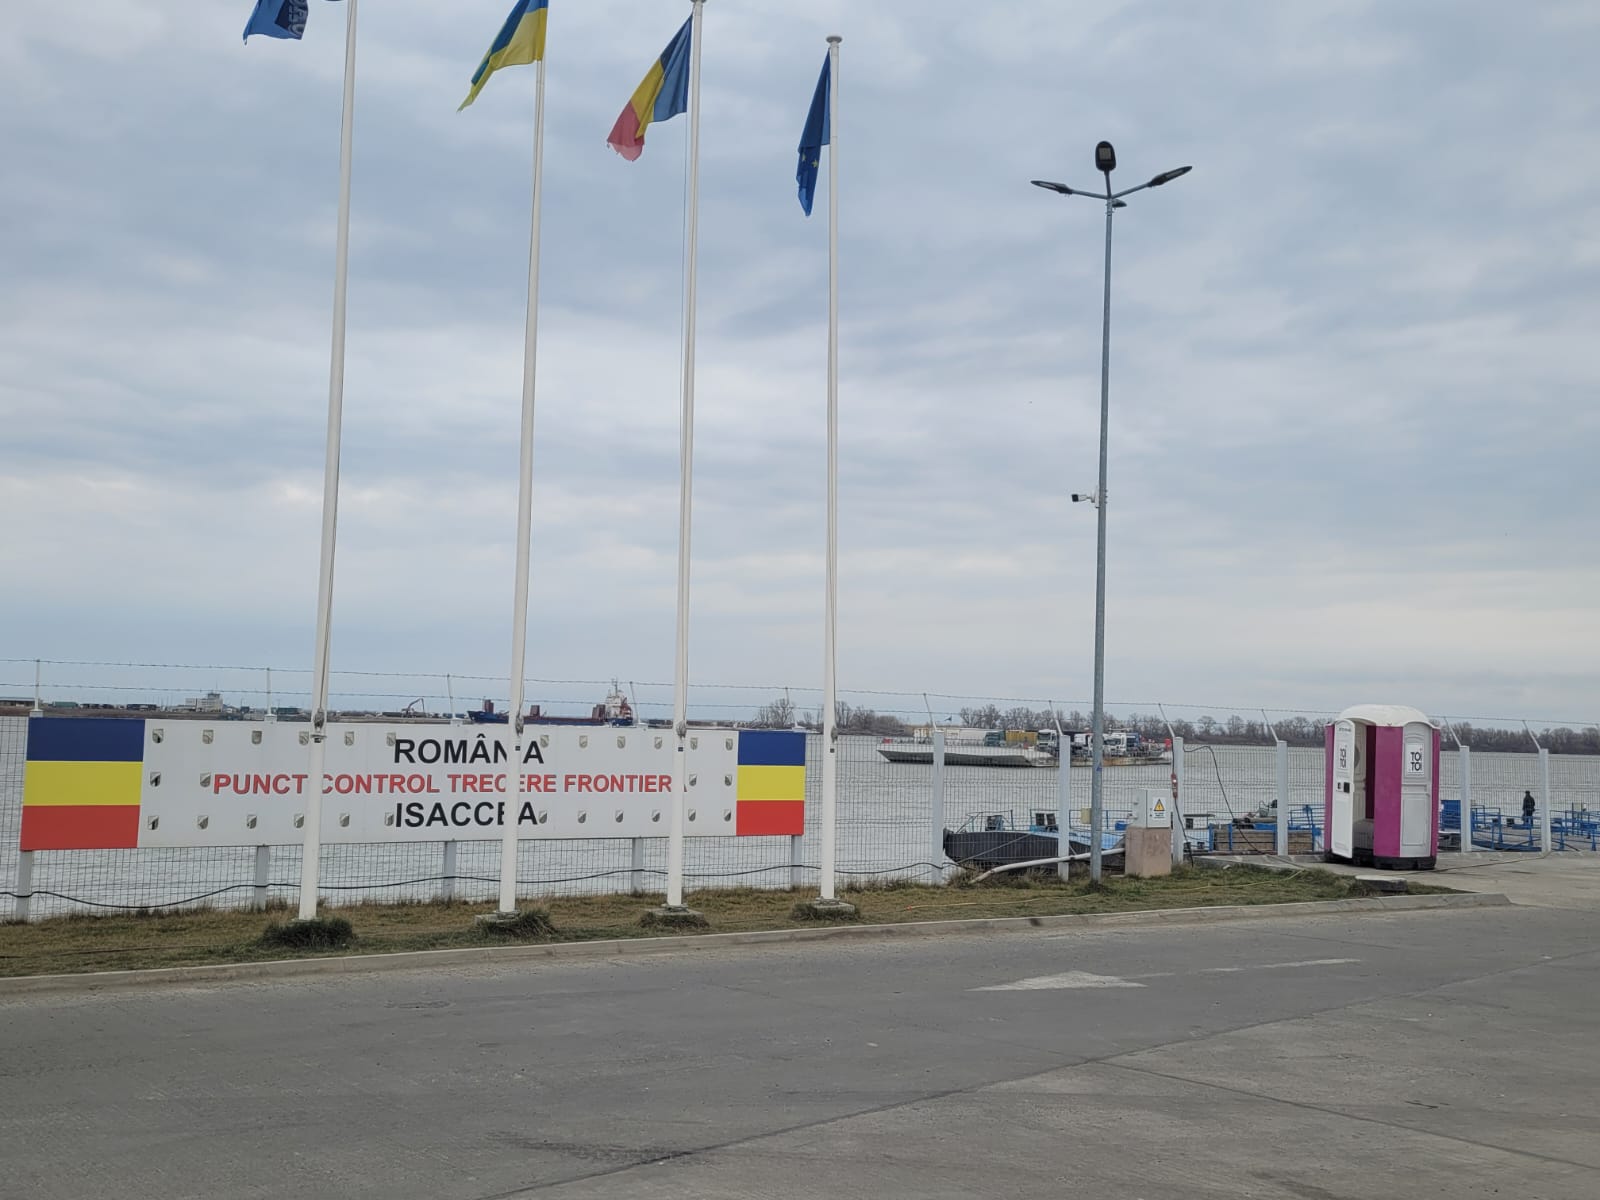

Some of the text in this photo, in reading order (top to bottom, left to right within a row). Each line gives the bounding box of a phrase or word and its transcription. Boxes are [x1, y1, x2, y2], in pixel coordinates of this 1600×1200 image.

[394, 733, 544, 764] ROMÂNA
[213, 774, 309, 794] PUNCT
[564, 774, 688, 793] FRONTIER
